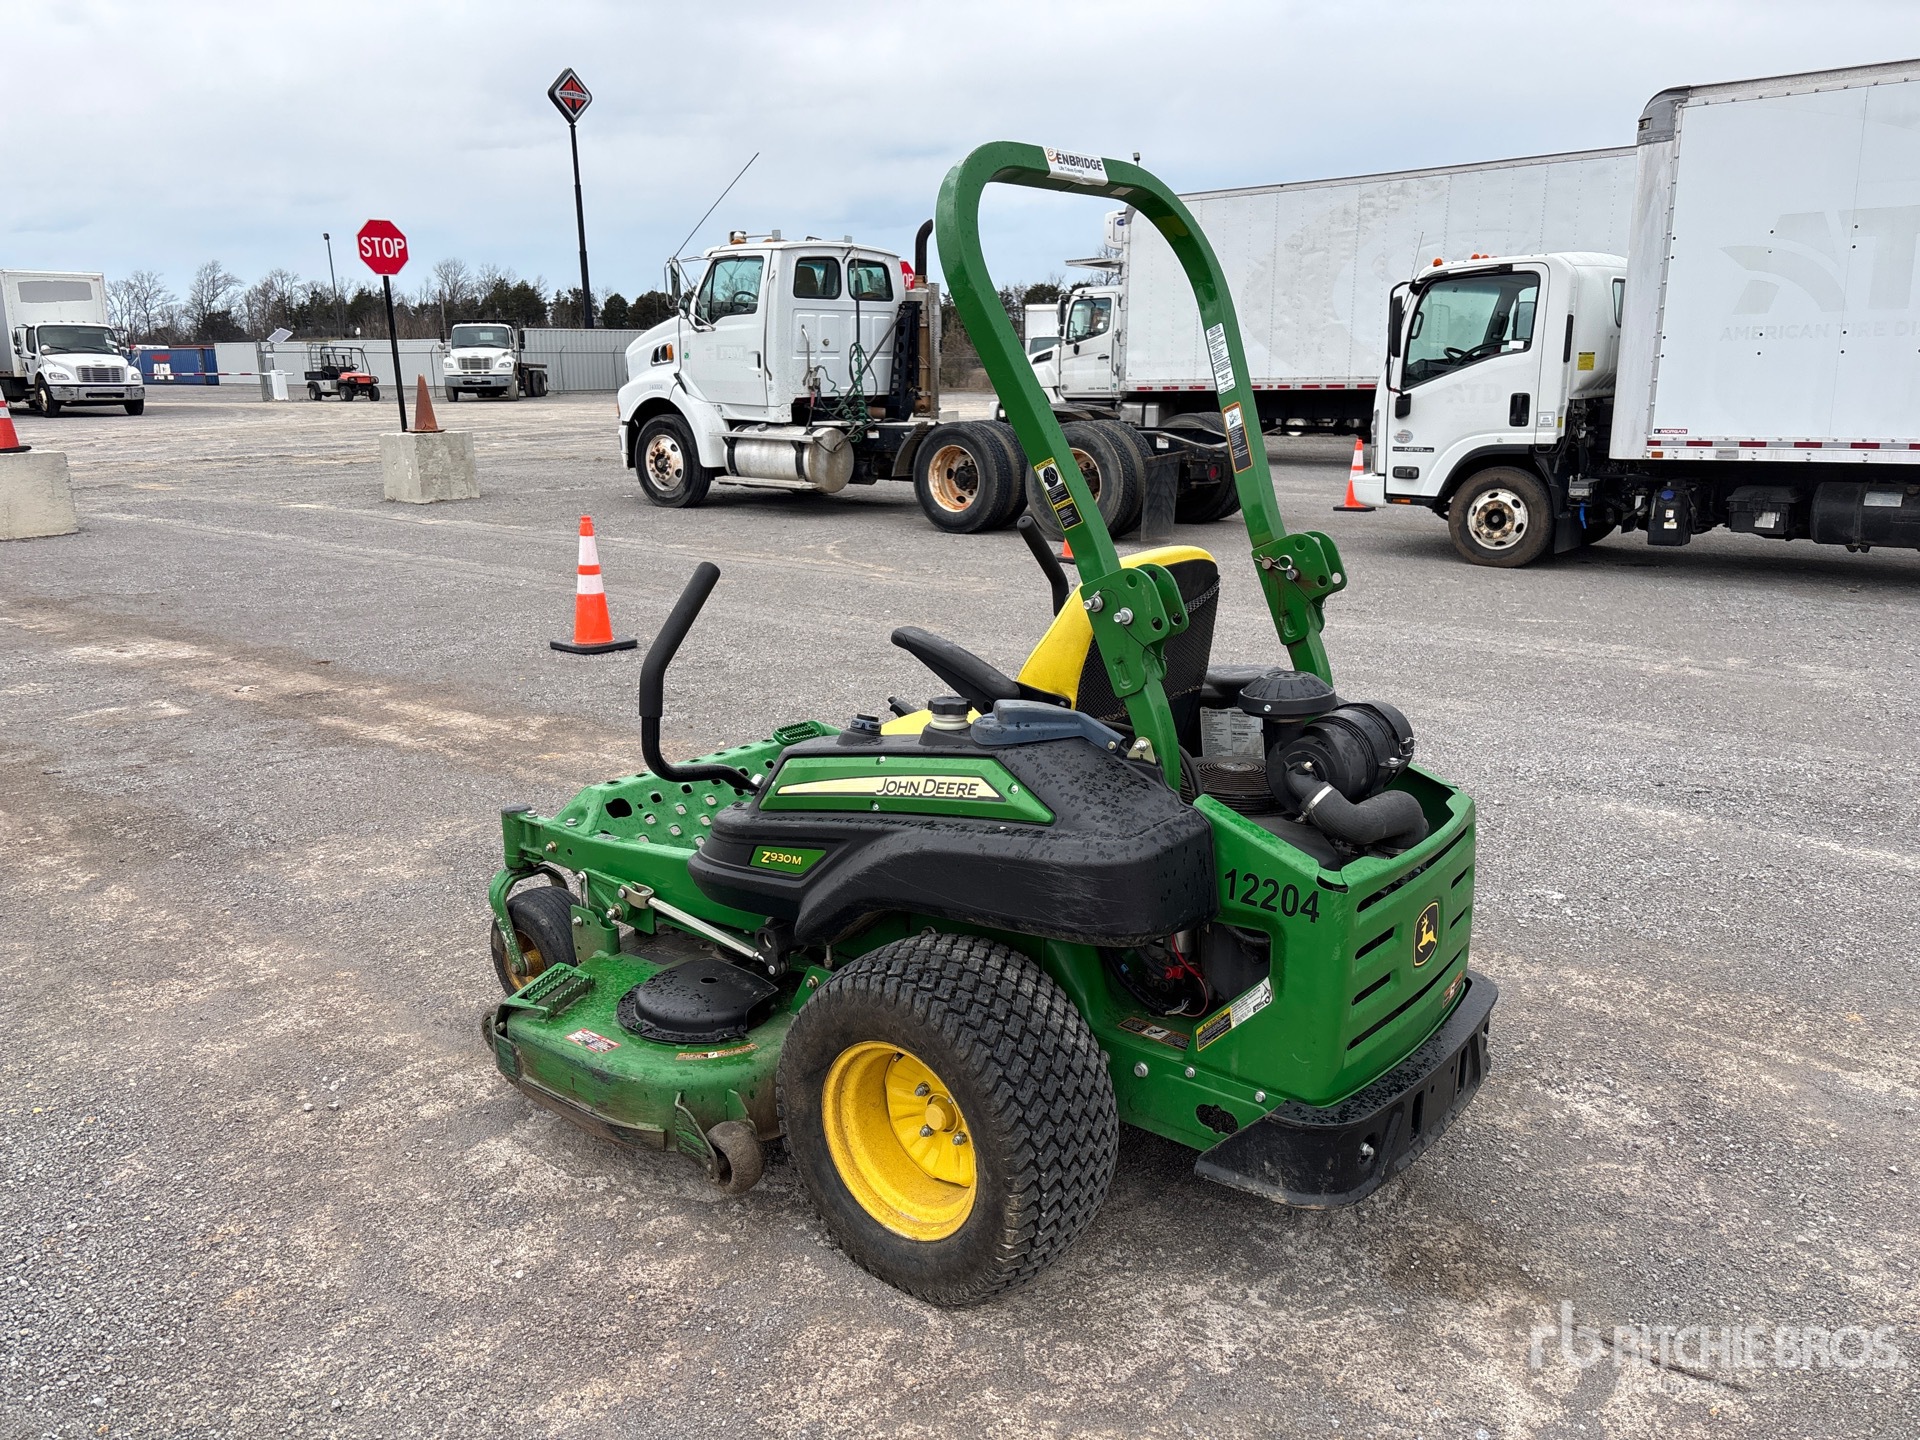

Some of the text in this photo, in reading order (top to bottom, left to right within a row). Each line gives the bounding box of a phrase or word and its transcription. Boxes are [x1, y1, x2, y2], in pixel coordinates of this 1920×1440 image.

[1055, 152, 1103, 171] ENBRIDGE
[360, 236, 405, 258] STOP
[903, 273, 915, 290] OP
[1719, 322, 1830, 342] AMERICAN
[1837, 321, 1888, 338] TIRE
[876, 778, 979, 796] JOHN DEERE
[761, 851, 802, 865] Z930M
[1225, 868, 1320, 924] 12204
